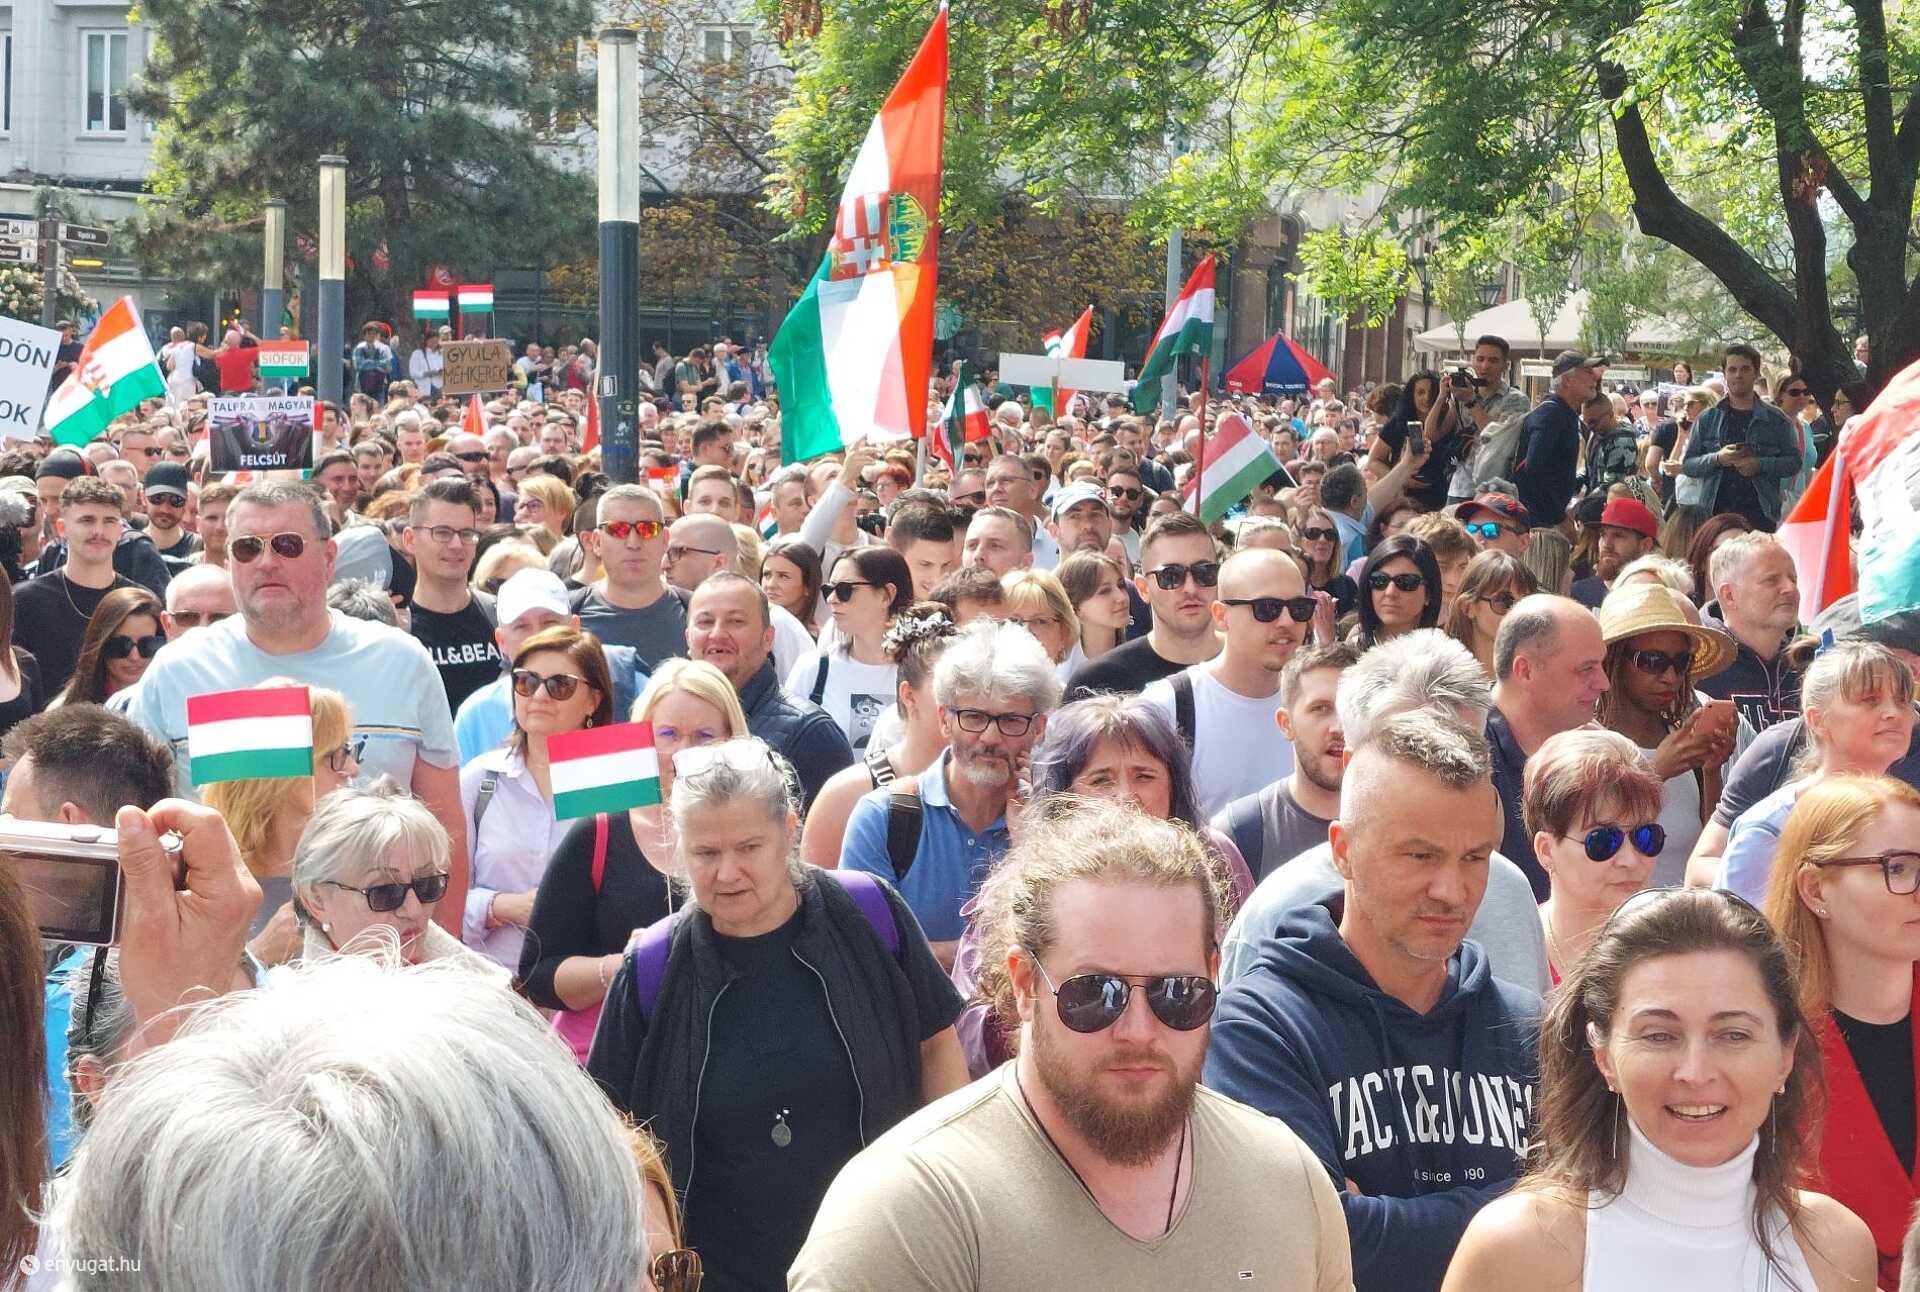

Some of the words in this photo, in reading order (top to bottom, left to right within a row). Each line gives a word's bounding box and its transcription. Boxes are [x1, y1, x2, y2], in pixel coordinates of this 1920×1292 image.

[447, 344, 500, 363] GYULA
[268, 400, 312, 411] MAGYAR
[428, 641, 504, 666] LL&BEA
